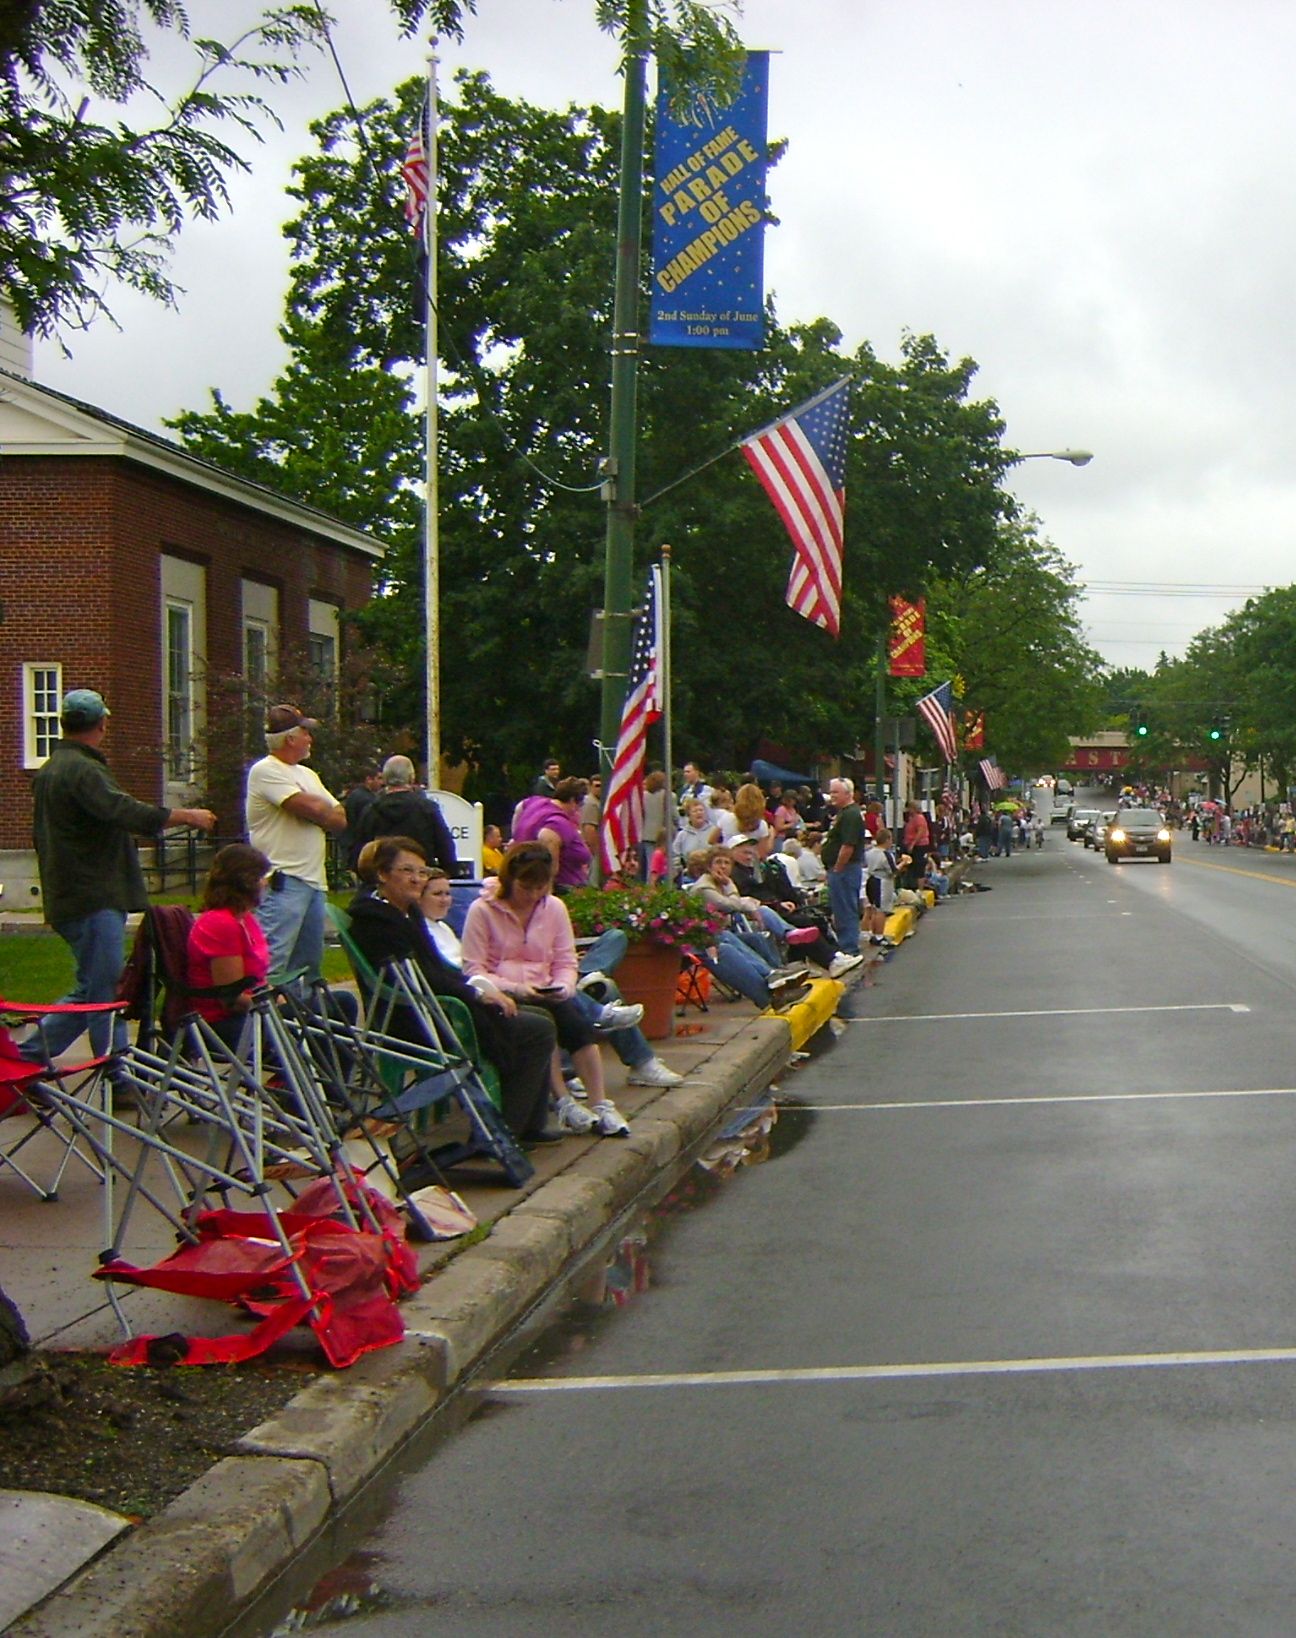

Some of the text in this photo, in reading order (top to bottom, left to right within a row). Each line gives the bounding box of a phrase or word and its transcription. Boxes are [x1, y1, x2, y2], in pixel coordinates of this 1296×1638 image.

[659, 125, 739, 195] HALL OF FAME
[659, 139, 759, 226] PARADE
[699, 190, 731, 224] OF
[656, 200, 761, 293] CHAMPIONS
[657, 310, 759, 322] 2nd Sunday of June
[687, 325, 729, 337] 1:00 pm
